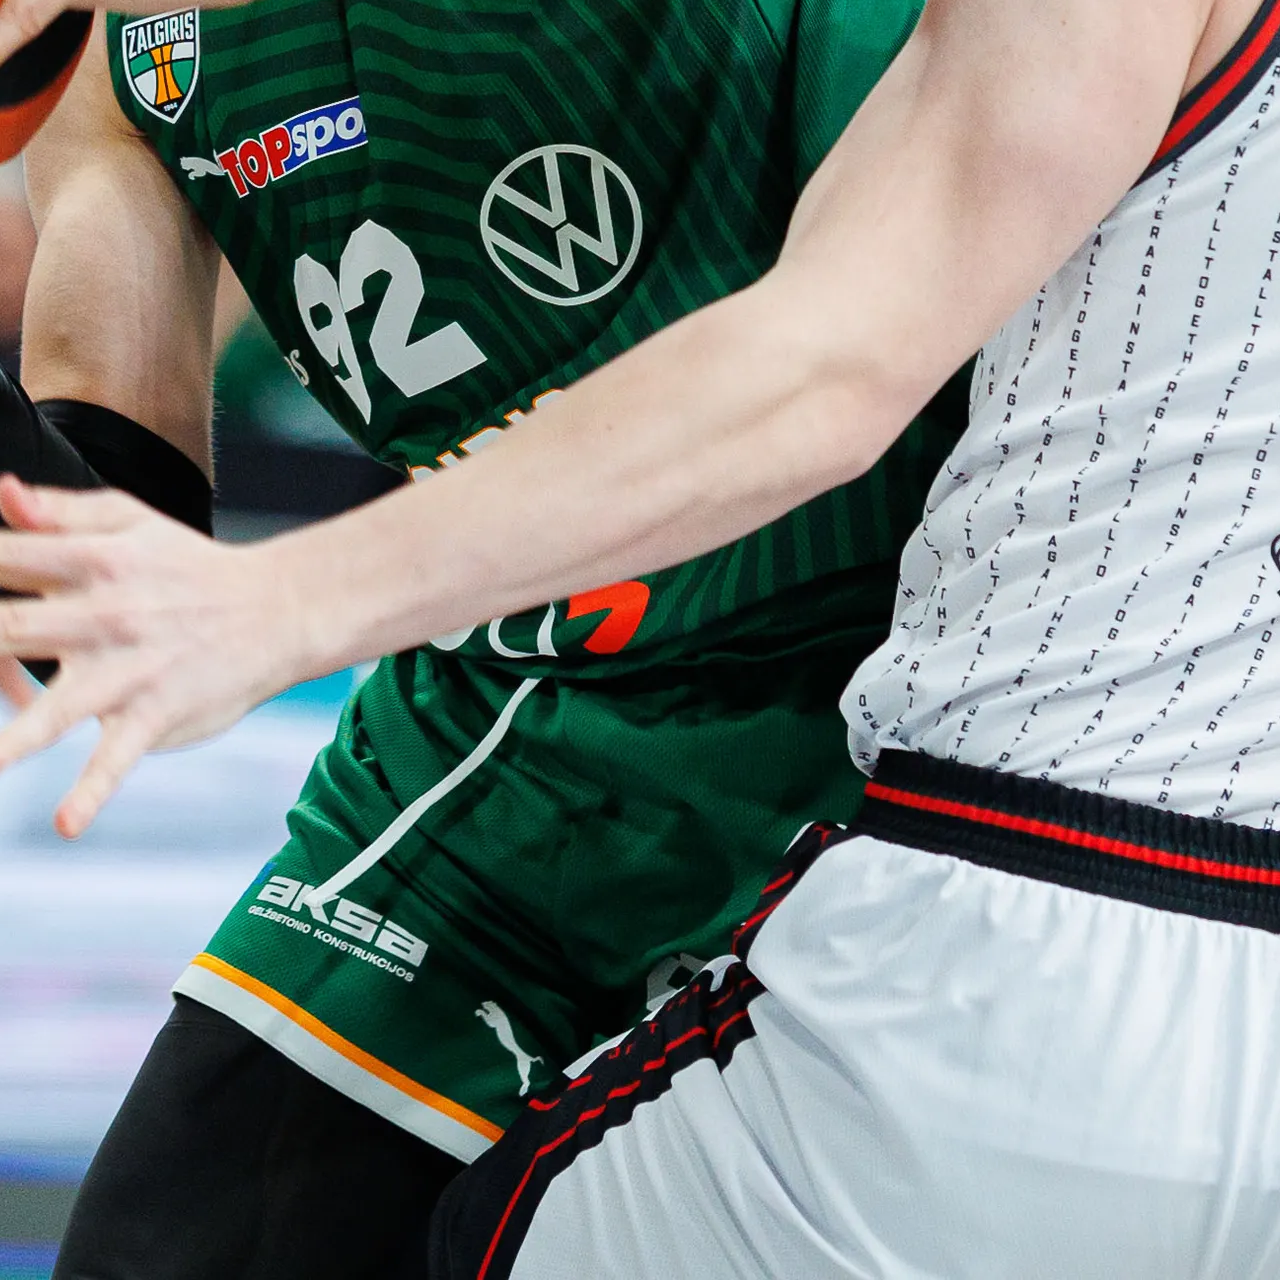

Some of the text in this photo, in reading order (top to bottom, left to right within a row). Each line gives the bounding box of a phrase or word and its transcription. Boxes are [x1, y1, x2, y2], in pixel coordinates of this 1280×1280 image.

[217, 106, 367, 199] TOPspo
[293, 218, 488, 426] 92
[256, 875, 430, 968] aksa
[313, 928, 415, 983] KONSTRUKCIJOS
